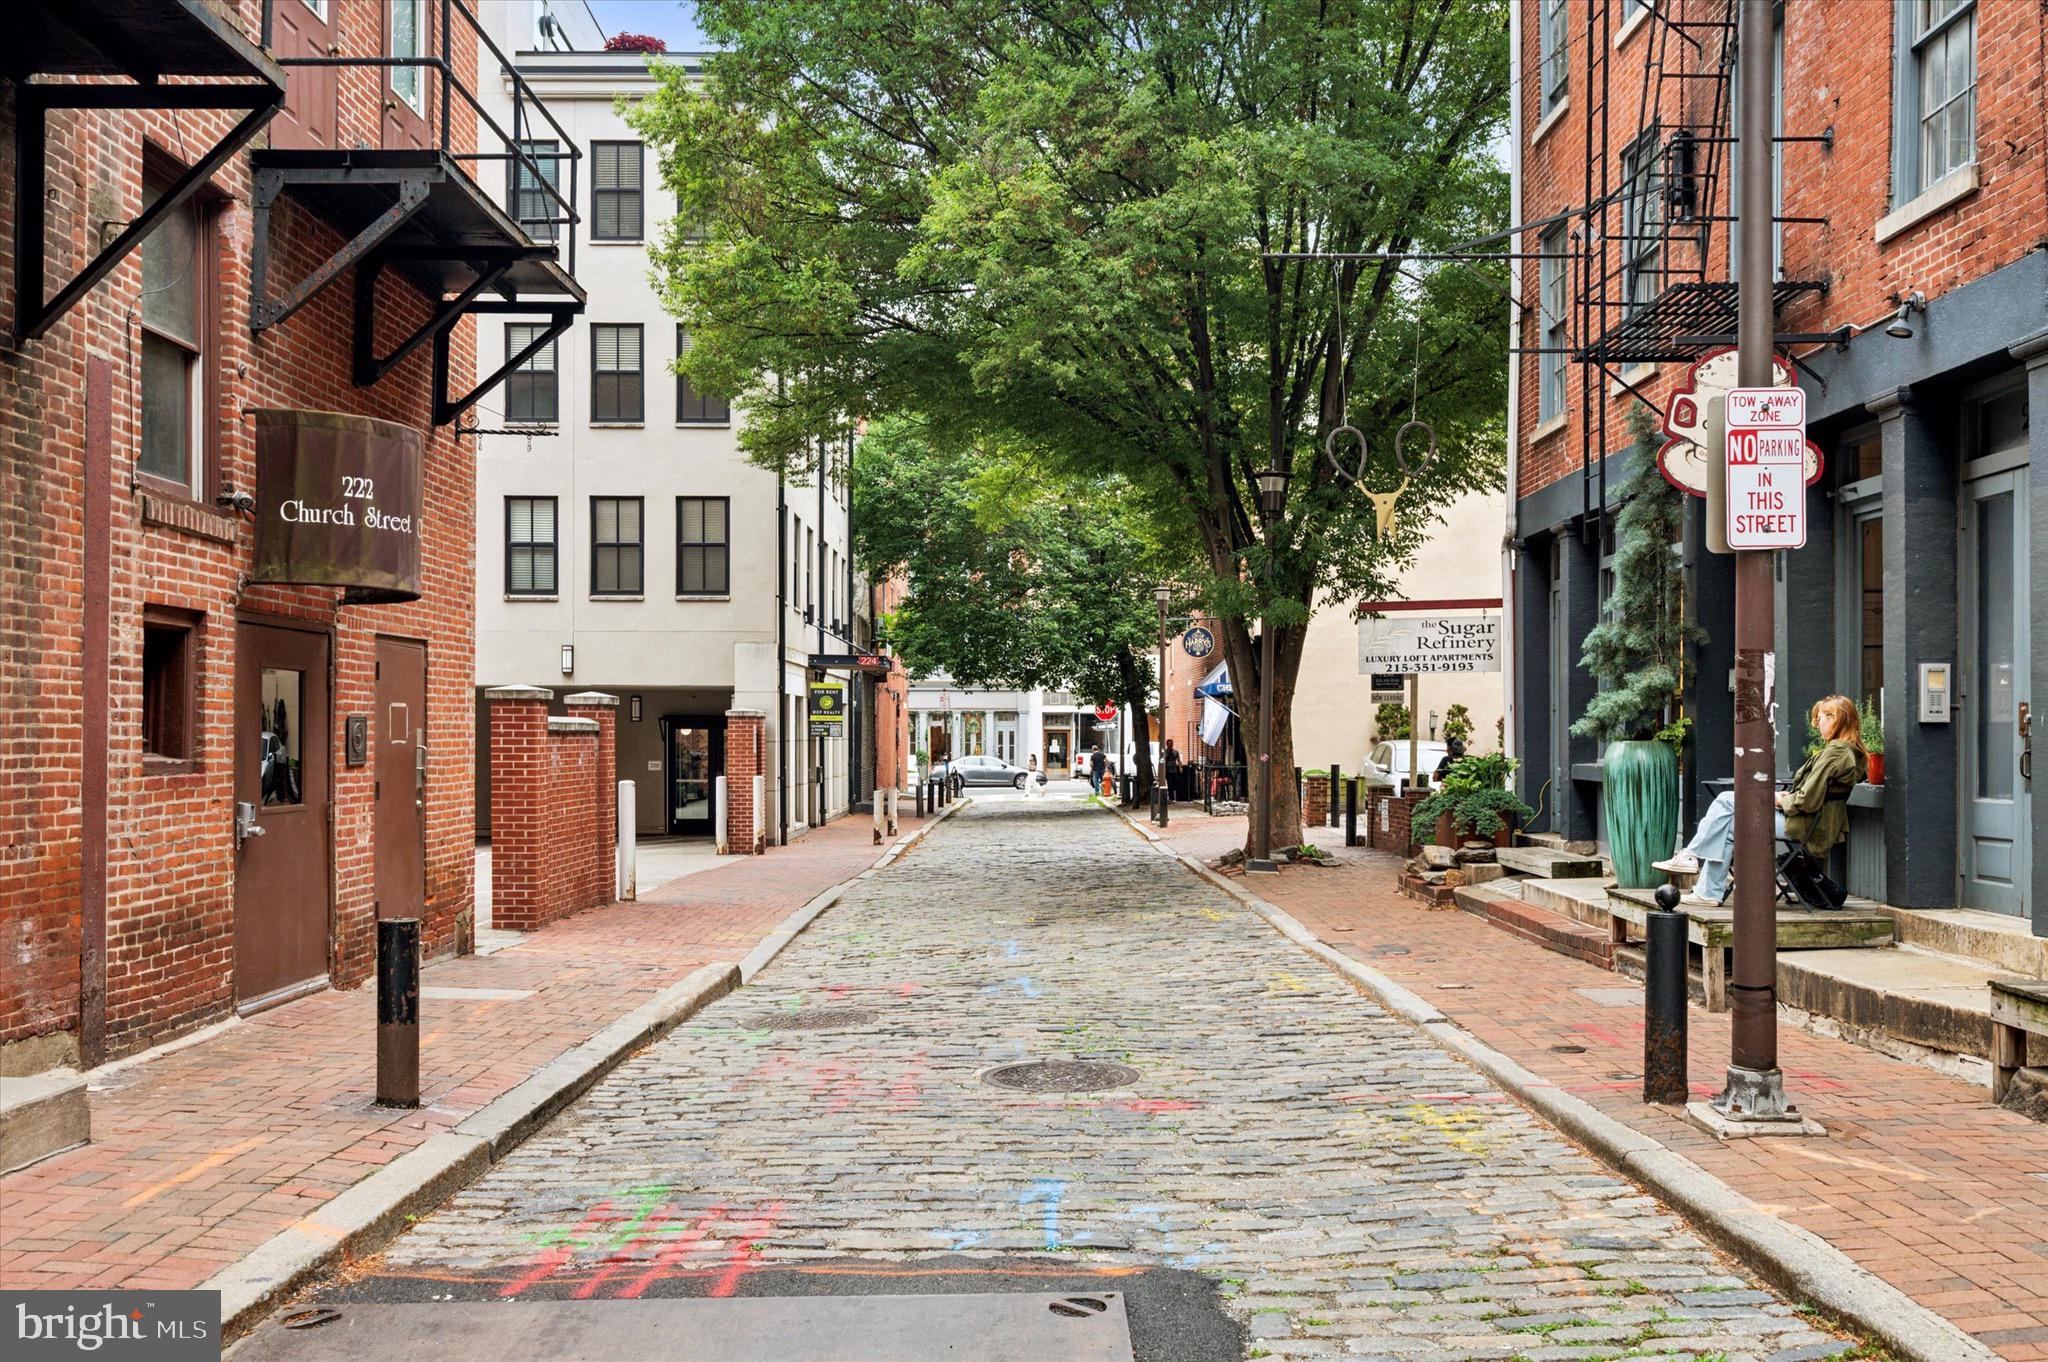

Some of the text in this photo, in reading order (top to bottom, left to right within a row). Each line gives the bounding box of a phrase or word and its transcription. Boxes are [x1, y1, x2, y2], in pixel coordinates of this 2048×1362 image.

[1732, 396, 1756, 407] TOW
[1750, 410, 1781, 422] ZONE
[1729, 433, 1800, 463] NO PARKING
[341, 475, 374, 500] 222
[1757, 472, 1772, 488] IN
[1747, 491, 1784, 510] THIS
[279, 499, 356, 527] Church
[364, 505, 412, 535] Street
[1736, 514, 1797, 534] STREET
[1421, 620, 1495, 639] the Sugar
[1416, 635, 1496, 652] Refinery
[861, 656, 877, 664] 224
[1366, 653, 1494, 663] LUXURY LOFT APARTMENTS
[1385, 662, 1474, 673] 215-351-9193
